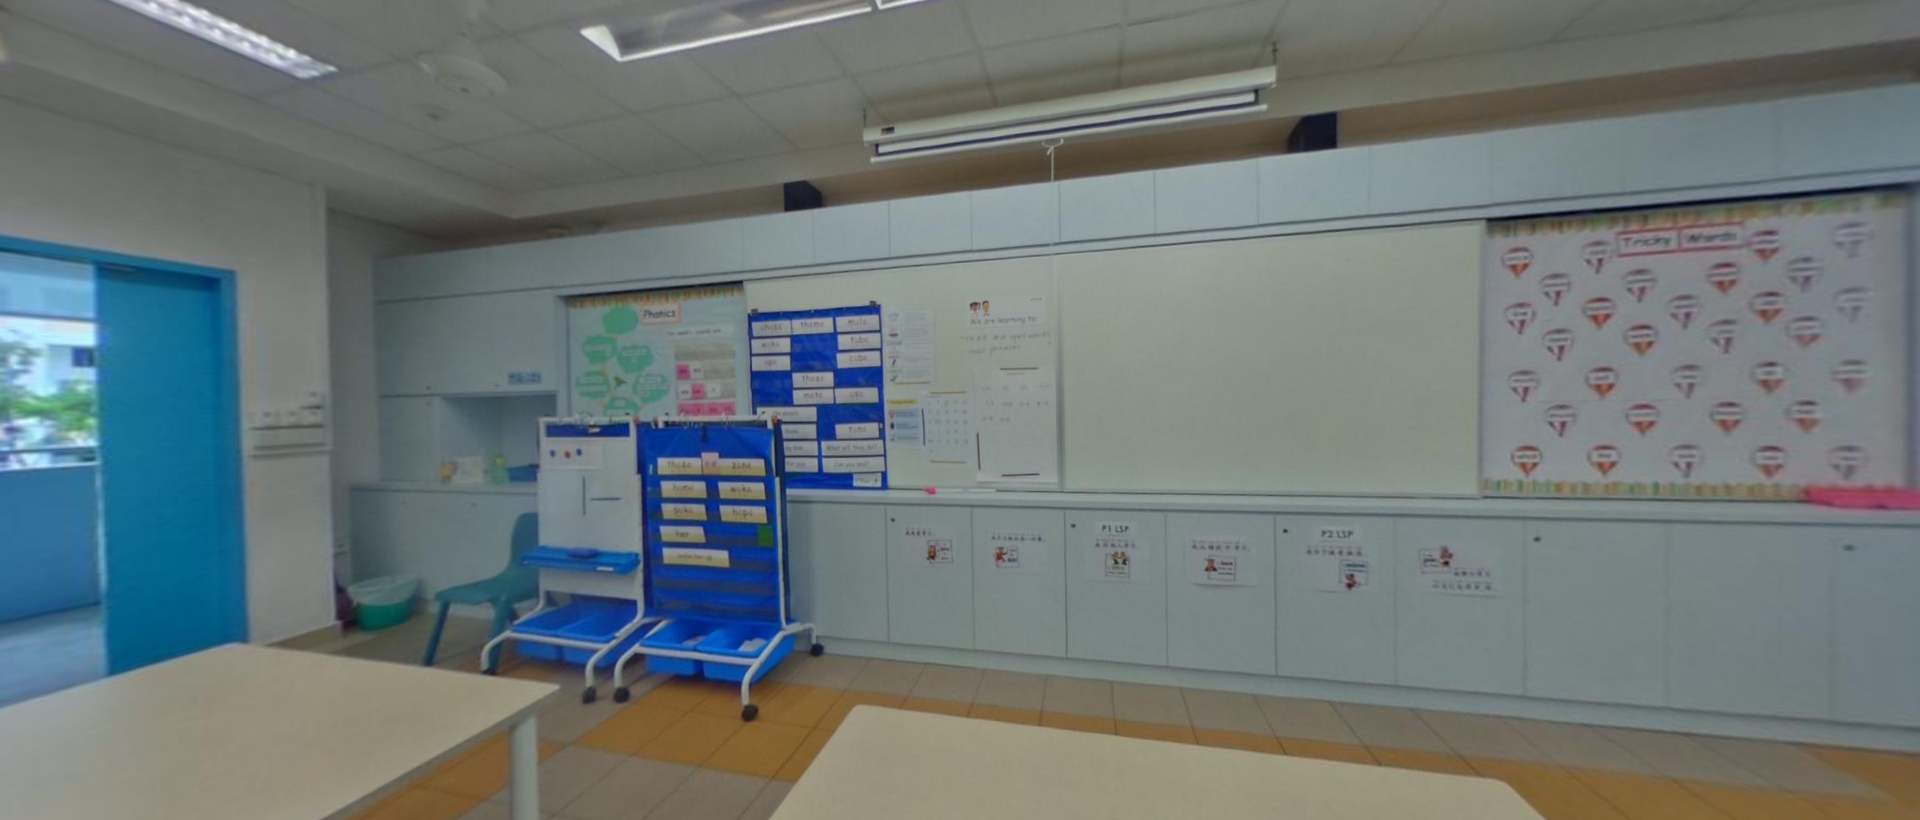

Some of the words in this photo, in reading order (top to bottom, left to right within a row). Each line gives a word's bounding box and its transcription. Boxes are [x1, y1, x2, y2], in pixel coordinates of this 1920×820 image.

[1622, 235, 1671, 249] Tricky
[643, 309, 676, 318] Phonics
[800, 319, 824, 328] theme
[970, 317, 982, 326] We
[997, 316, 1027, 326] learning
[802, 373, 824, 382] these
[672, 483, 694, 492] home
[732, 508, 753, 518] hope
[1101, 524, 1111, 533] P1
[1115, 525, 1129, 533] LSP
[1321, 530, 1333, 539] P2
[1337, 530, 1354, 539] LSP
